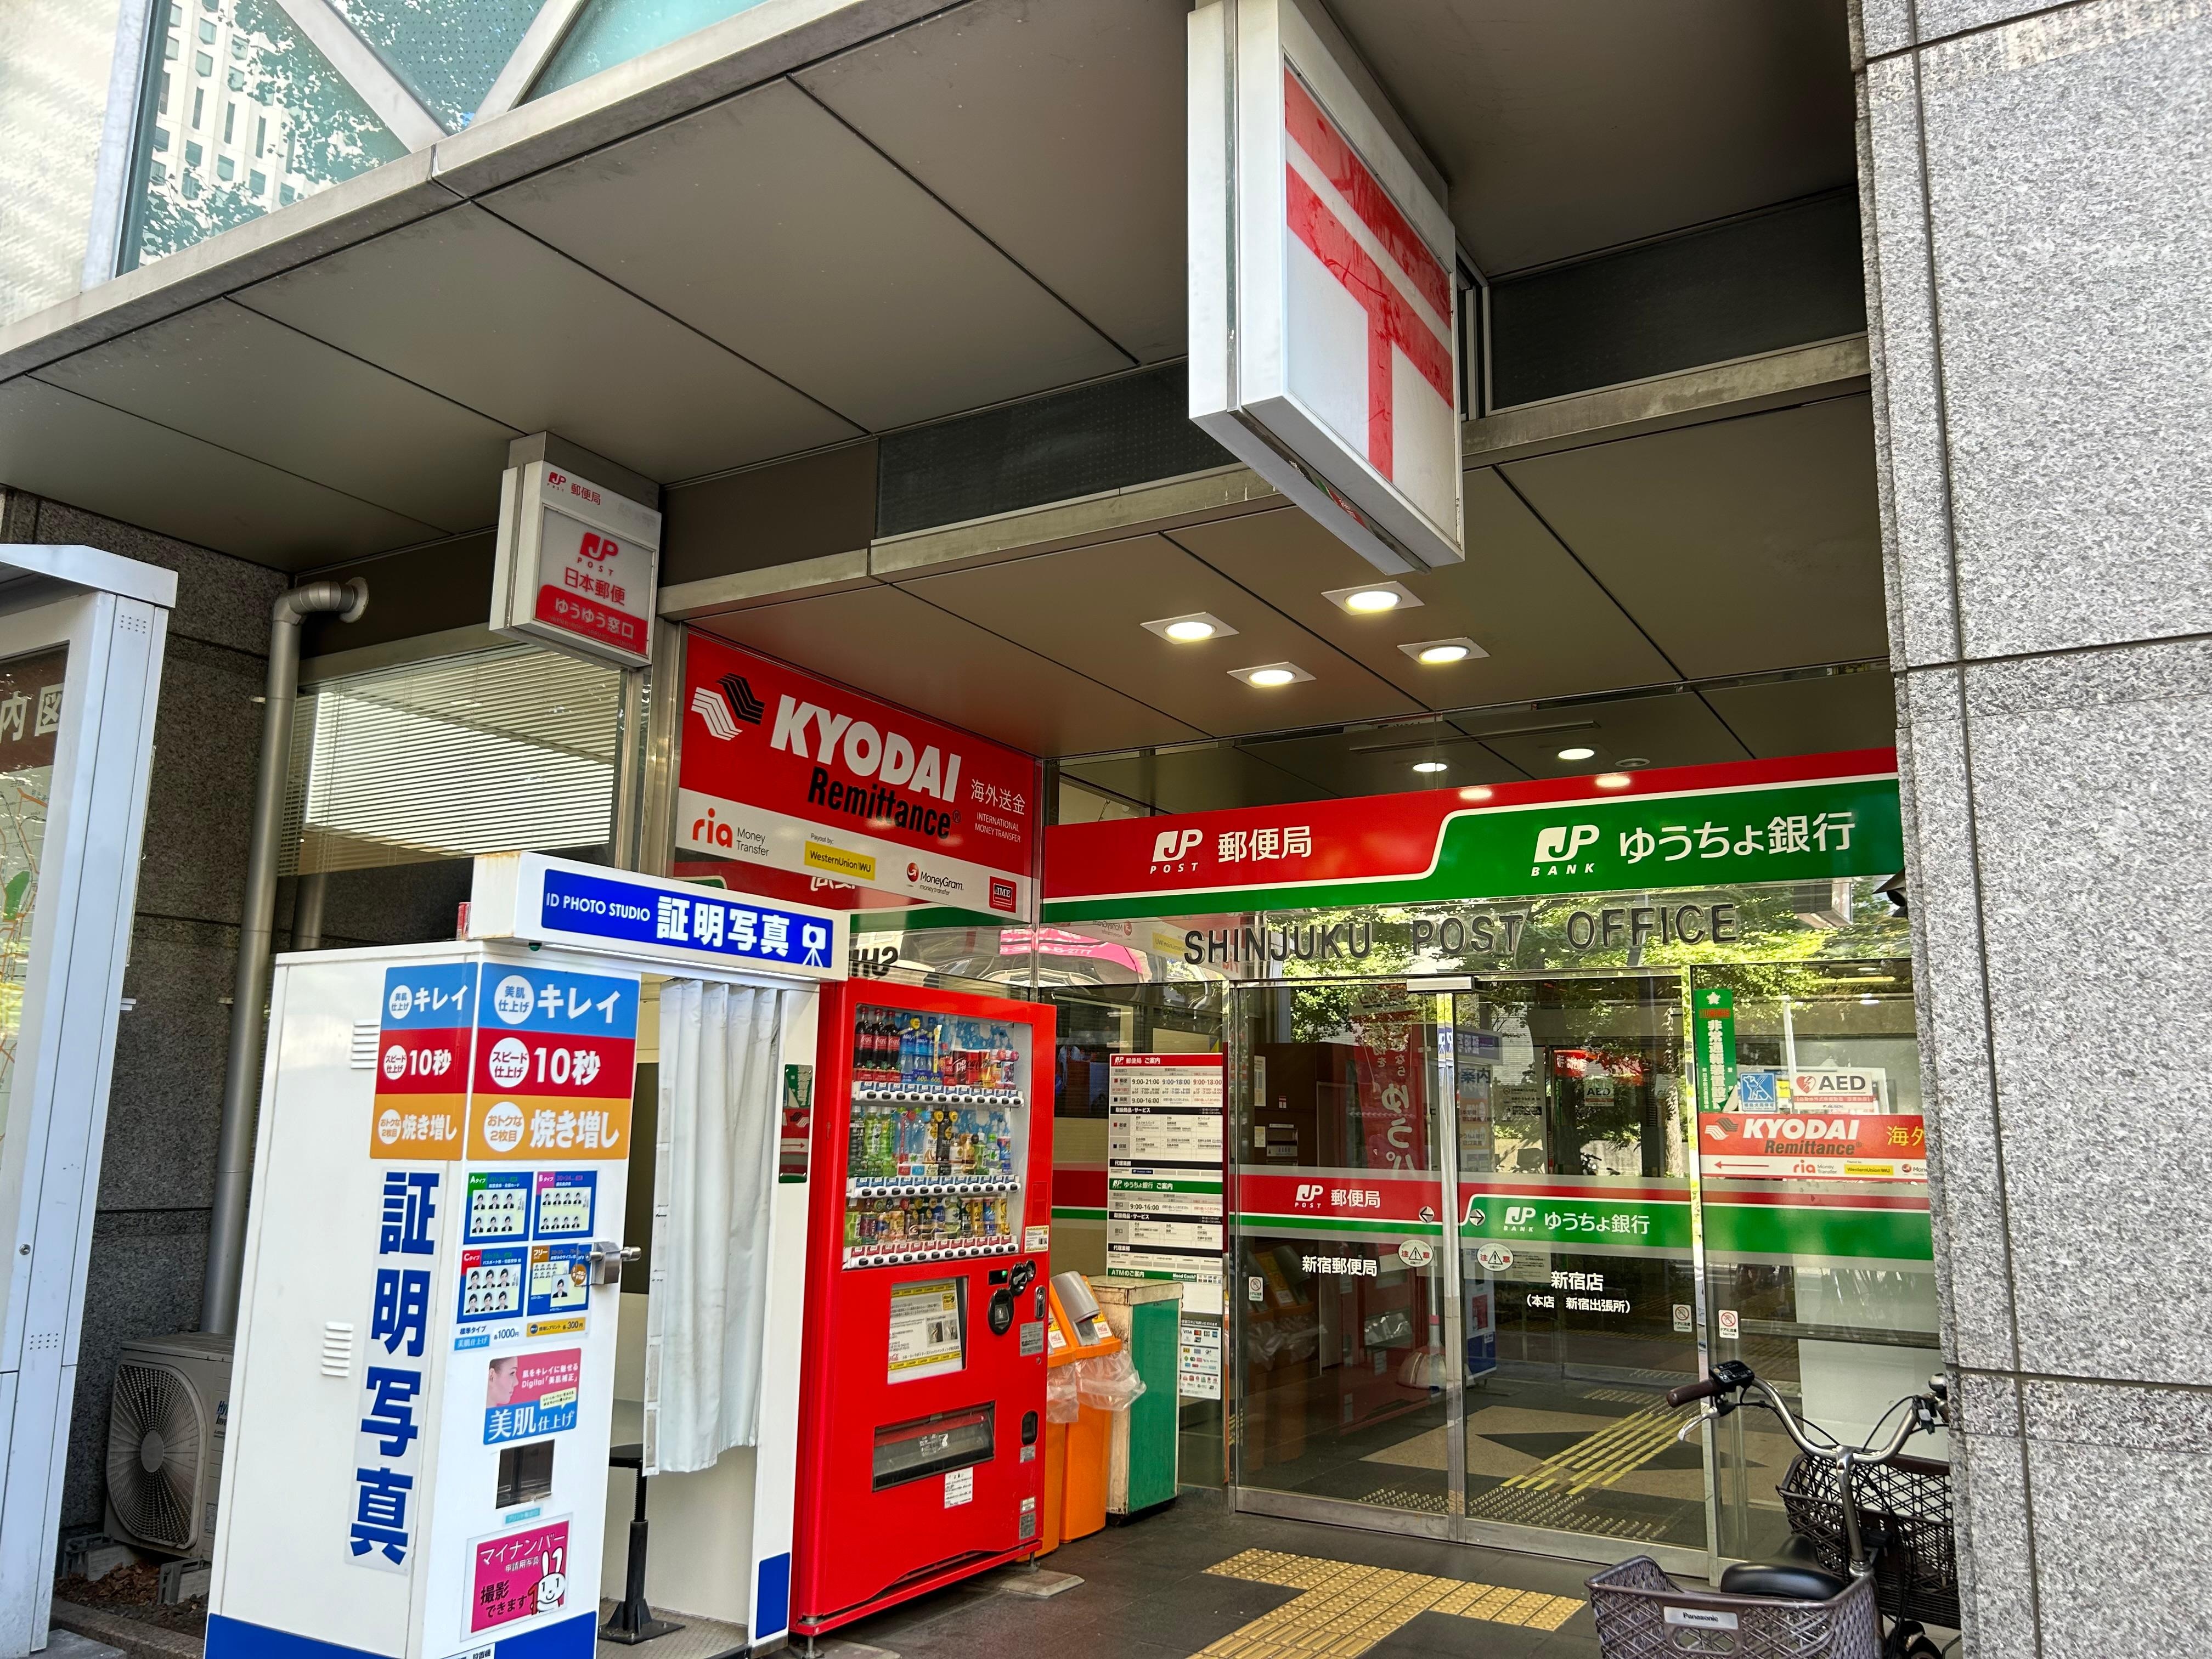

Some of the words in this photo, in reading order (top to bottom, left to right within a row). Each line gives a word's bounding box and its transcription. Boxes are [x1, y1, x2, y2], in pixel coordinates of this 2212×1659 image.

[571, 483, 601, 505] 郵便局
[580, 532, 619, 561] JP
[577, 557, 614, 576] POST
[565, 567, 625, 606] 日本郵便
[555, 597, 634, 639] ゆうゆう窓口
[770, 694, 962, 803] KYODAI
[971, 779, 1025, 815] 海外送金
[692, 808, 733, 848] ria
[977, 812, 1019, 832] INTERNATIONAL
[737, 827, 765, 844] Money
[811, 833, 826, 843] Payout
[975, 823, 995, 835] MONEY
[995, 828, 1020, 843] TRANSFER
[1619, 811, 1855, 864] ゆうちょ銀行
[736, 840, 769, 856] Transfer
[1153, 829, 1203, 862] JP
[1218, 826, 1313, 863] 郵便局
[1534, 825, 1599, 863] JP
[810, 850, 857, 870] WesternUnion
[1149, 862, 1199, 874] POST
[1531, 863, 1596, 877] BANK
[920, 871, 963, 890] MoneyGram
[546, 892, 560, 907] ID
[563, 895, 606, 915] PHOTO
[609, 901, 651, 922] STUDIO
[657, 895, 791, 957] 証明写真
[1184, 920, 1373, 966] SHINJUKU
[1413, 914, 1525, 956] POST
[1567, 904, 1739, 951] OFFICE
[414, 985, 468, 1012] キレイ
[505, 985, 526, 998] 美肌
[391, 1001, 409, 1011] 仕上げ
[498, 1000, 529, 1013] 仕上げ
[538, 984, 621, 1023] キレイ
[385, 1054, 407, 1063] スピード
[409, 1049, 452, 1076] 10秒
[493, 1052, 528, 1064] スピード
[534, 1047, 601, 1086] 10秒
[386, 1064, 404, 1074] 仕上げ
[494, 1066, 523, 1079] 仕上げ
[1818, 1075, 1866, 1091] AED
[380, 1118, 401, 1127] おトクな
[402, 1114, 457, 1141] 焼き増し
[487, 1115, 523, 1128] おトクな
[530, 1109, 619, 1149] 焼き増し
[1743, 1118, 1860, 1139] KYODAI
[381, 1128, 398, 1137] 2枚目
[490, 1129, 517, 1142] 2枚目
[1793, 1159, 1816, 1173] ria
[1296, 1184, 1323, 1201] JP
[1330, 1189, 1380, 1209] 郵便局
[1504, 1206, 1536, 1225] JP
[1544, 1211, 1650, 1234] ゆうちょ銀行
[1111, 1269, 1144, 1278] ATMのご案内
[1302, 1255, 1378, 1277] 新宿郵便局
[1550, 1271, 1604, 1291] 新宿店
[350, 1172, 441, 1566] 証明写真
[488, 1406, 575, 1442] 美肌仕上げ
[480, 1533, 565, 1565] マイナンバー
[480, 1580, 509, 1606] 撮影
[486, 1595, 527, 1618] できます
[1683, 1611, 1719, 1623] Panasonic
